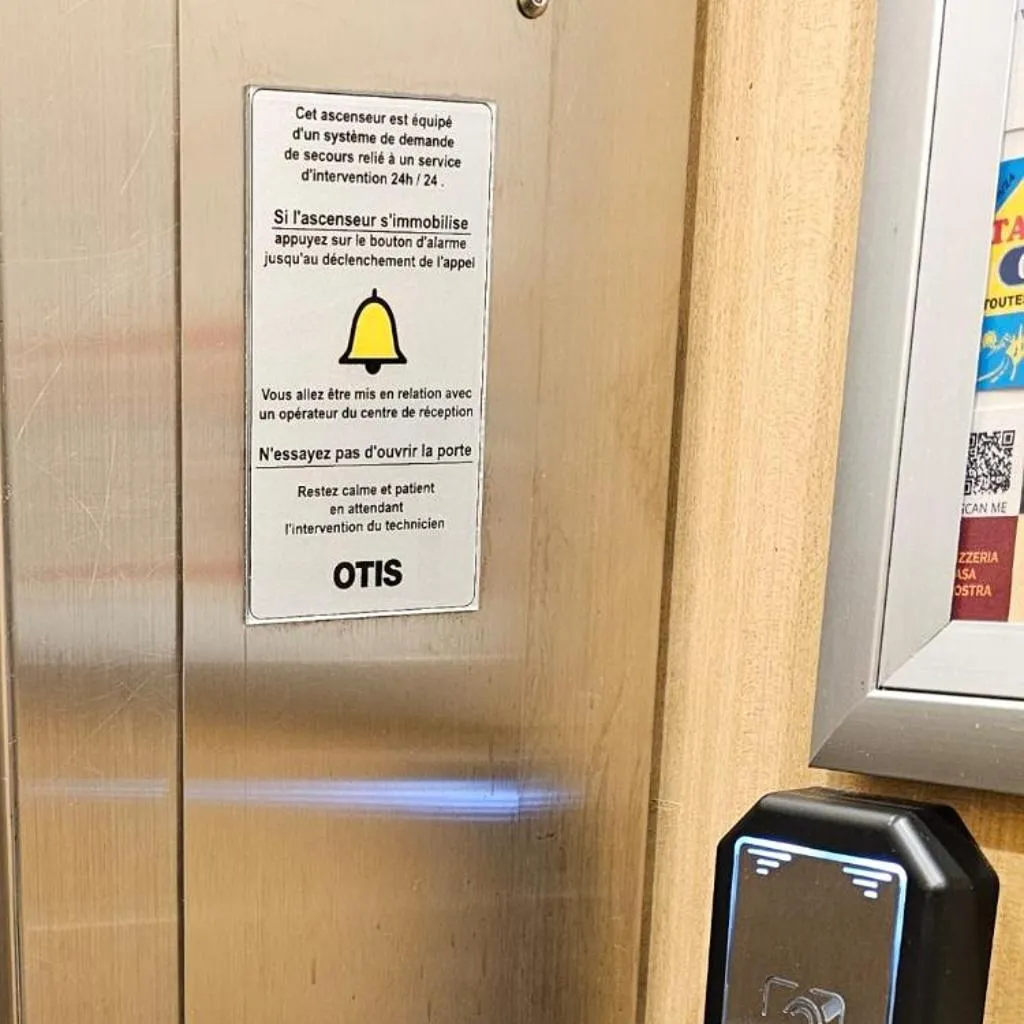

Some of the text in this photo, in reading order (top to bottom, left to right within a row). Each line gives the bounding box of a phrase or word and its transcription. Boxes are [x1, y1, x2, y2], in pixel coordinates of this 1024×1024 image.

[295, 106, 453, 129] Cet ascenseur est équipé
[292, 127, 454, 148] d'un système de demande
[284, 149, 461, 168] de secours relié à un service
[301, 169, 387, 185] d'intervention
[391, 172, 413, 186] 24h
[424, 174, 438, 186] 24
[274, 209, 469, 230] Si l'ascenseur s'immobilise
[275, 234, 467, 249] appuyez sur le bouton d'alarme
[263, 251, 475, 271] jusqu'au déclenchement de l'appel
[984, 294, 1024, 311] TOUTE
[261, 387, 472, 401] Vous allez être mis en relation avec
[259, 406, 473, 422] un opérateur du centre de réception
[259, 443, 472, 463] N'essayez pas d'ouvrir la porte
[297, 483, 435, 497] Restez calme et patient
[330, 502, 404, 515] en attendant
[990, 501, 1008, 513] ME
[285, 518, 444, 535] l'intervention du technicien
[333, 558, 403, 590] OTIS
